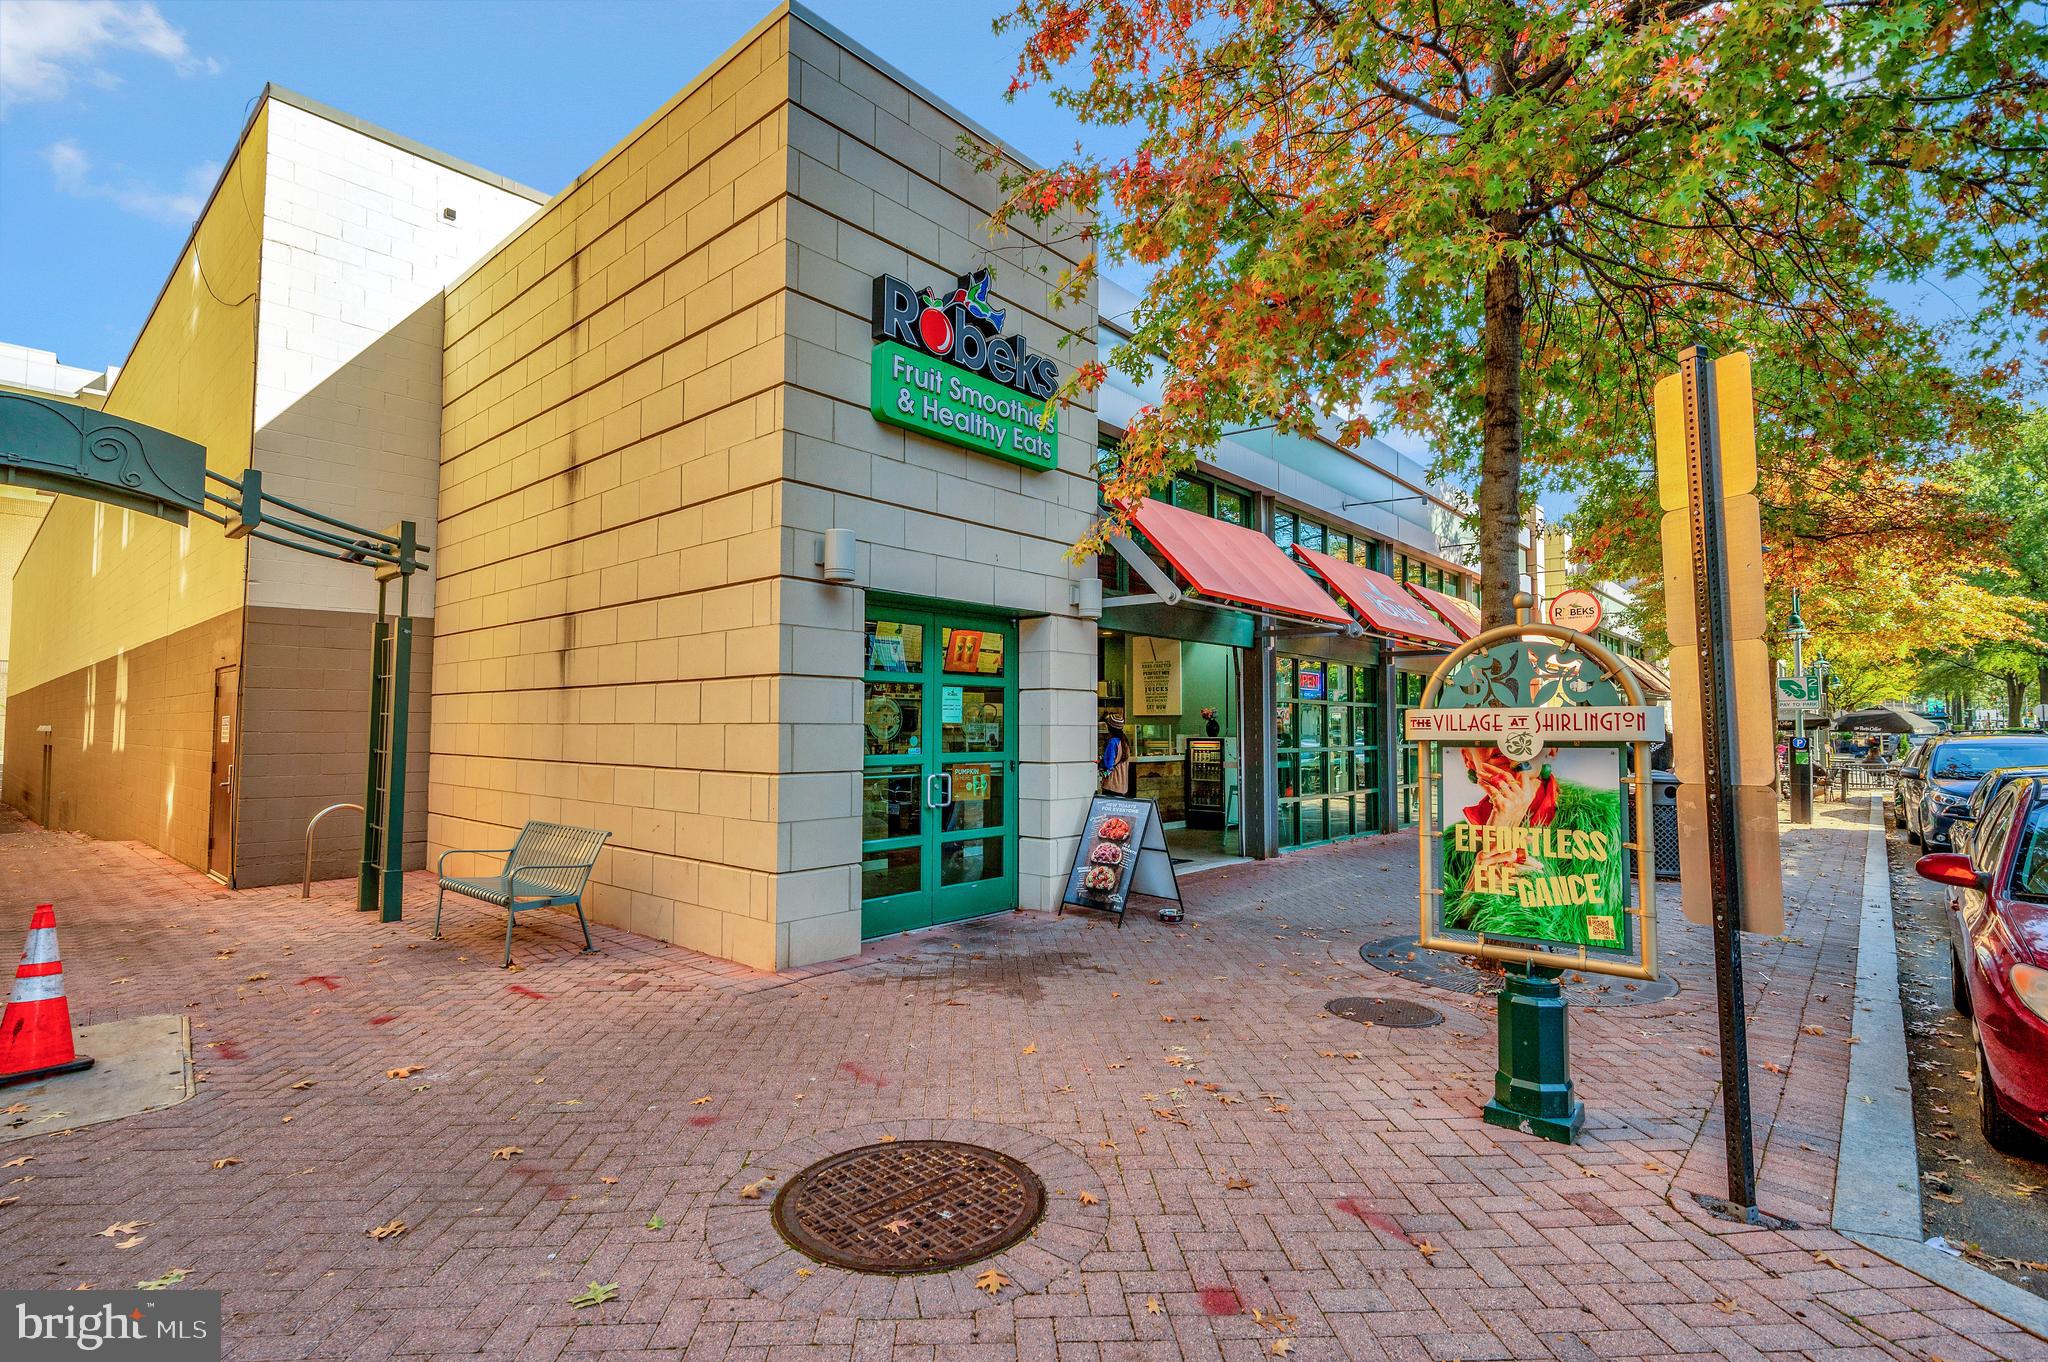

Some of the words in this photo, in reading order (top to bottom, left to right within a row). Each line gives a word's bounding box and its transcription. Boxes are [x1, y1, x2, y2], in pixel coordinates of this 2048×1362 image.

[892, 353, 943, 394] Fruit
[949, 375, 1055, 434] Smoothies
[897, 387, 915, 414] &
[922, 397, 1007, 448] Healthy
[1013, 426, 1052, 459] Eats
[1411, 719, 1431, 728] THE
[1433, 714, 1503, 732] VILLAGE
[1510, 718, 1528, 726] AT
[1535, 711, 1646, 733] SHIRLINGTON
[1455, 823, 1609, 862] EFFORTLESS
